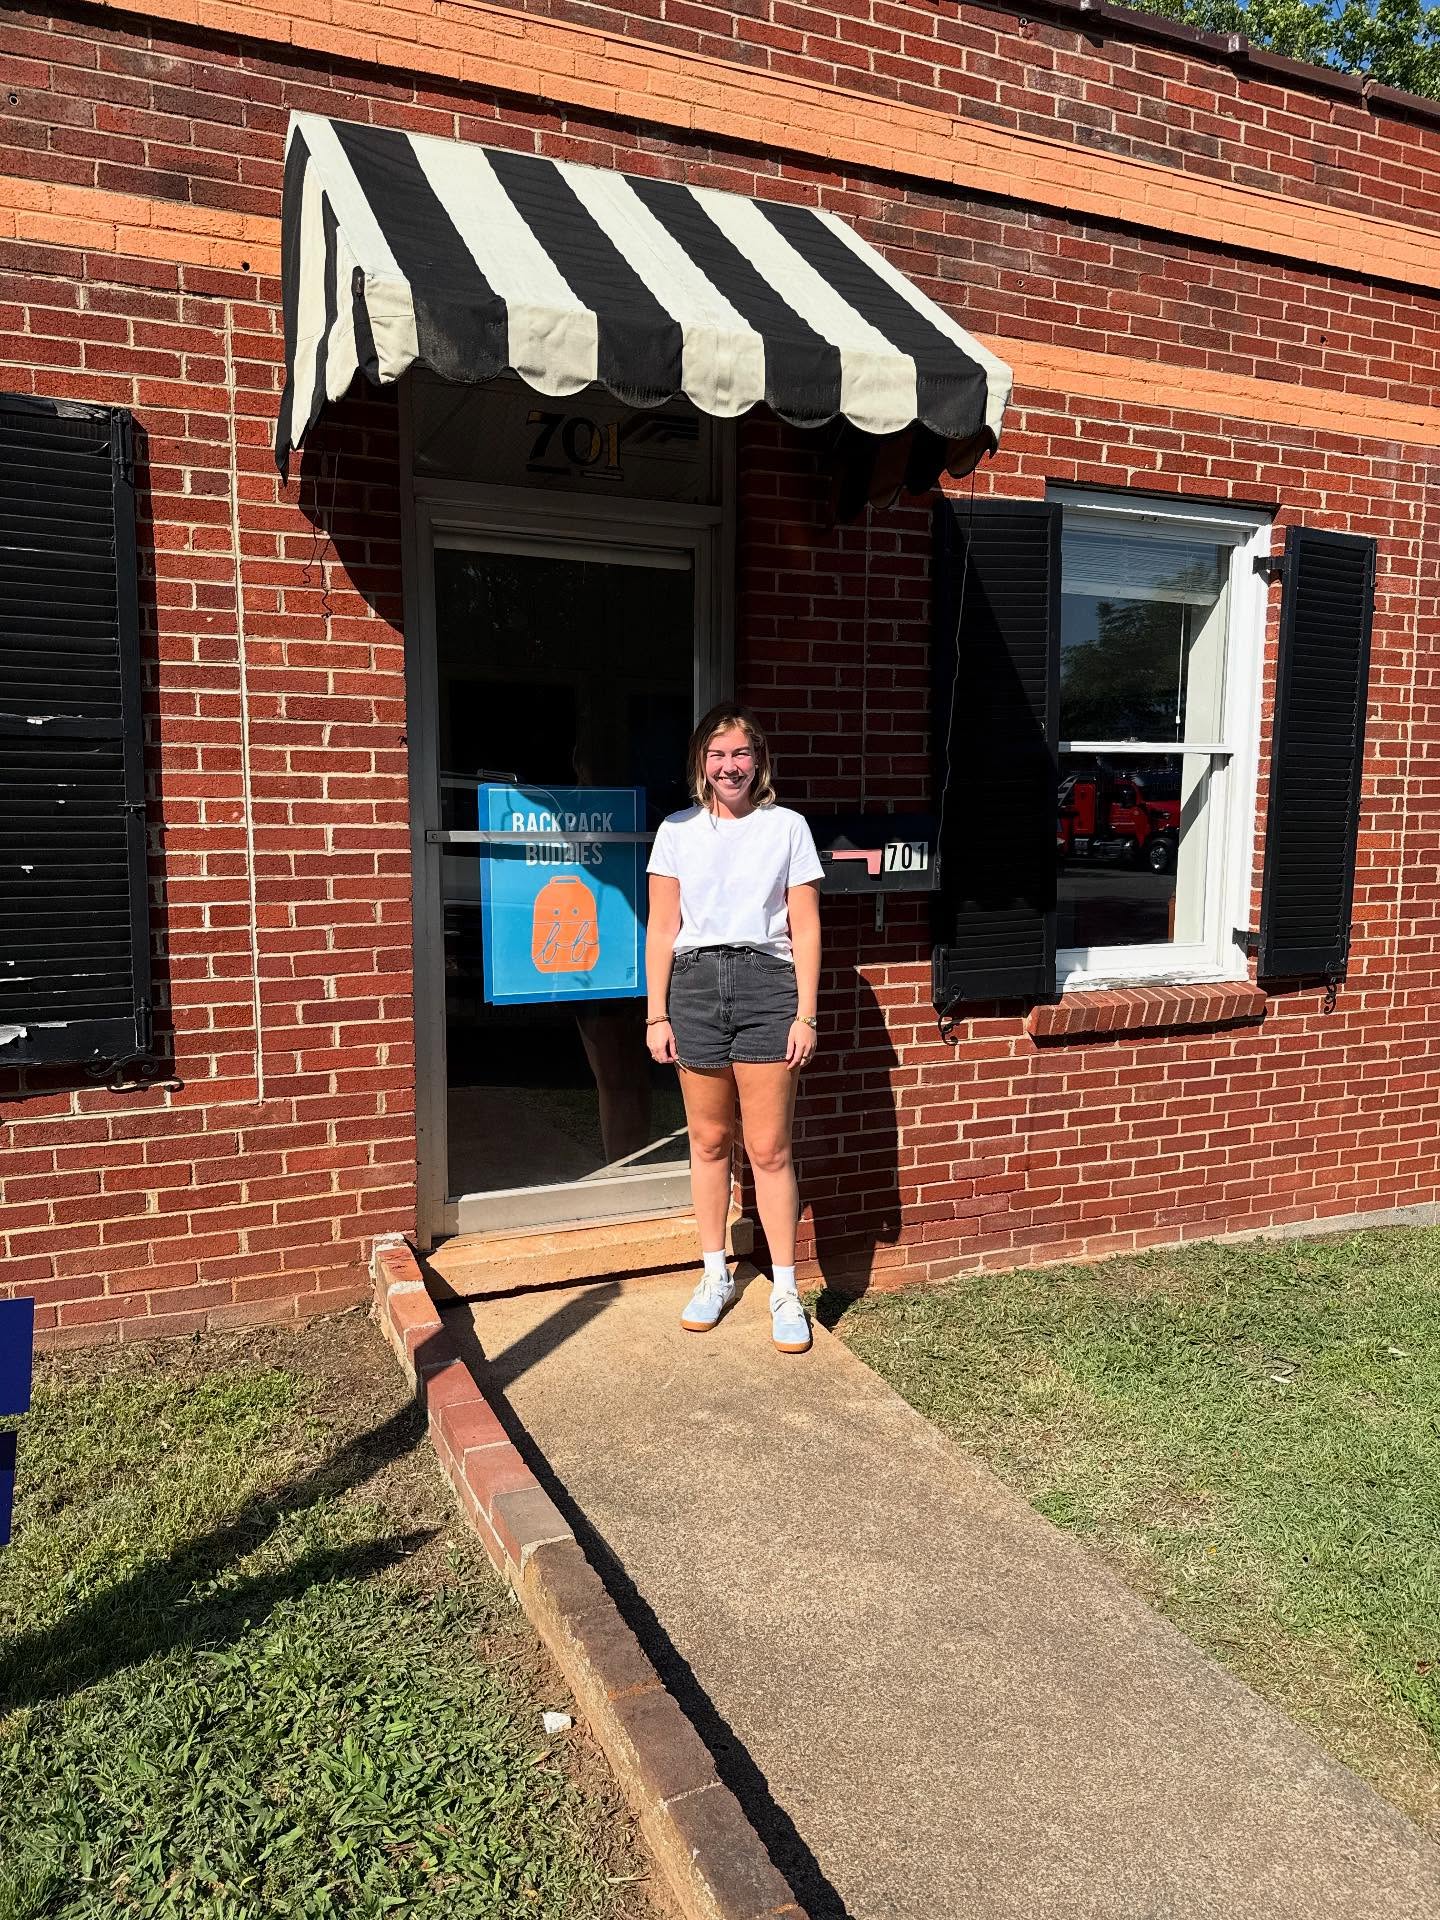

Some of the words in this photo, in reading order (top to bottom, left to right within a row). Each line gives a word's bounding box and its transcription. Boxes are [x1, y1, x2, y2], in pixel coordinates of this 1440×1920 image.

[526, 410, 623, 471] 701
[512, 812, 613, 831] BACKPACK
[526, 842, 603, 865] BUDDIES
[887, 843, 925, 870] 701
